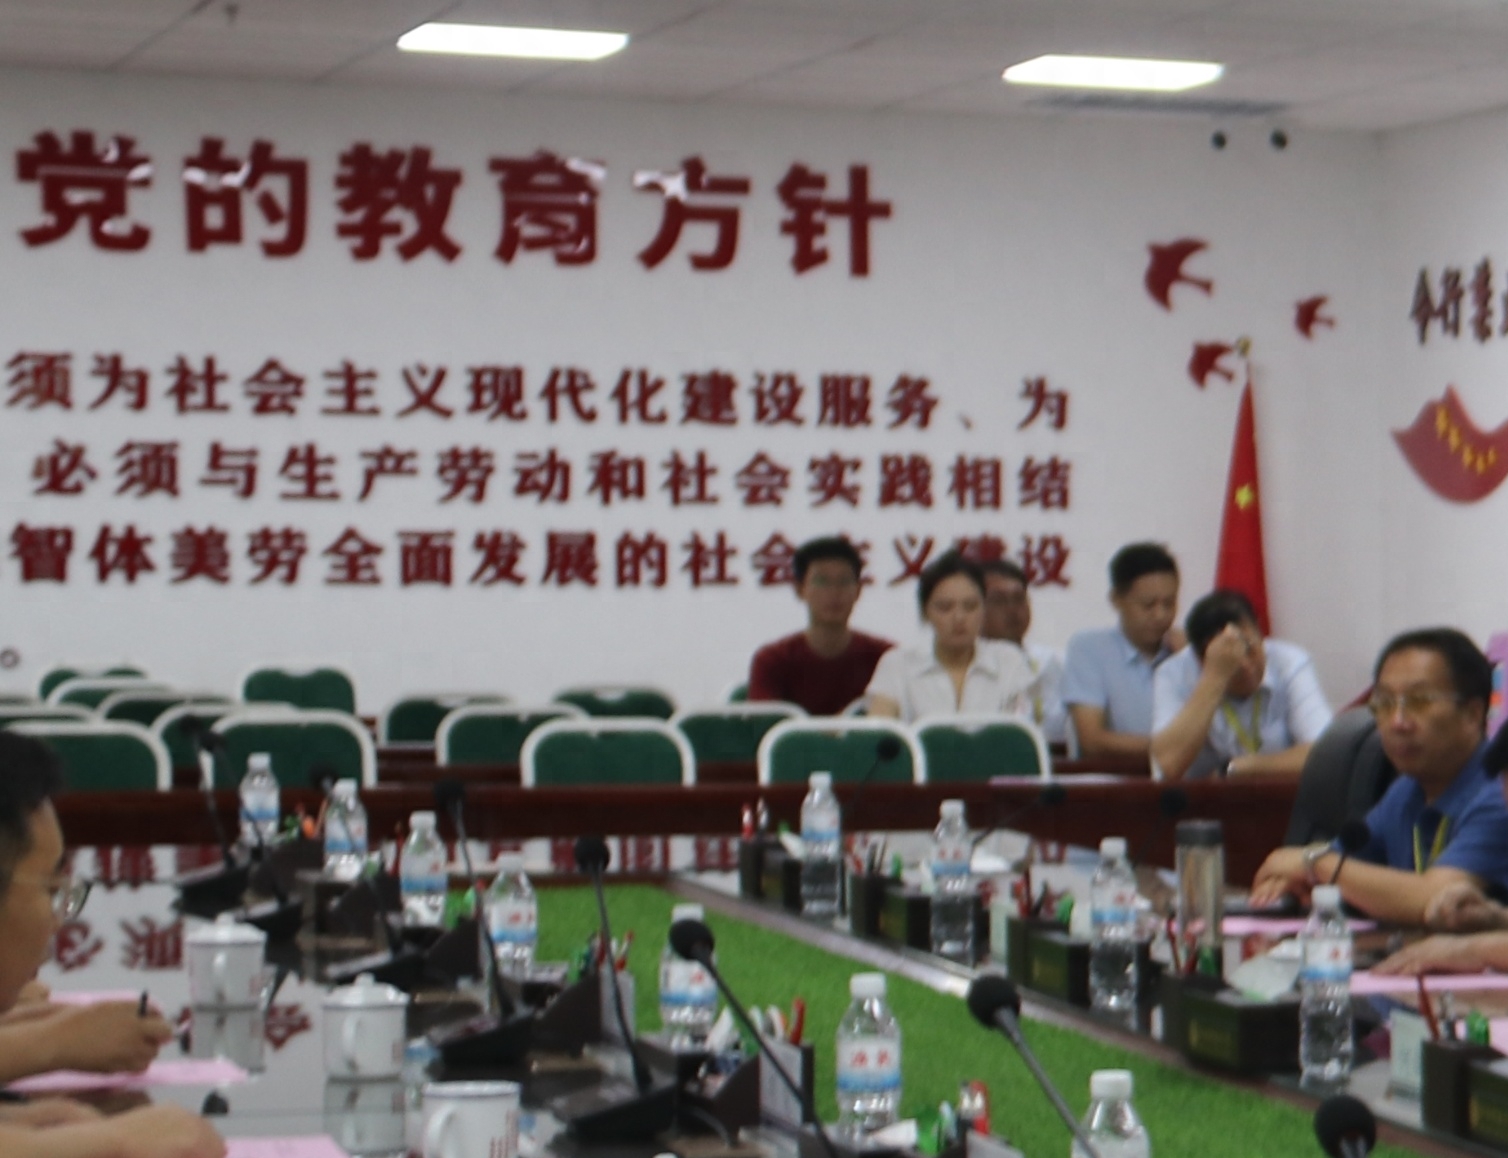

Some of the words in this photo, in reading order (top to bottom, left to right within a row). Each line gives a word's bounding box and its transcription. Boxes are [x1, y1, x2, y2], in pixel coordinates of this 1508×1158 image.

[15, 129, 894, 277] 党的教育方针
[6, 351, 1069, 430] 须为社会主义现代化建设服务、为
[33, 439, 1070, 509] 必须与生产劳动和社会实践相结
